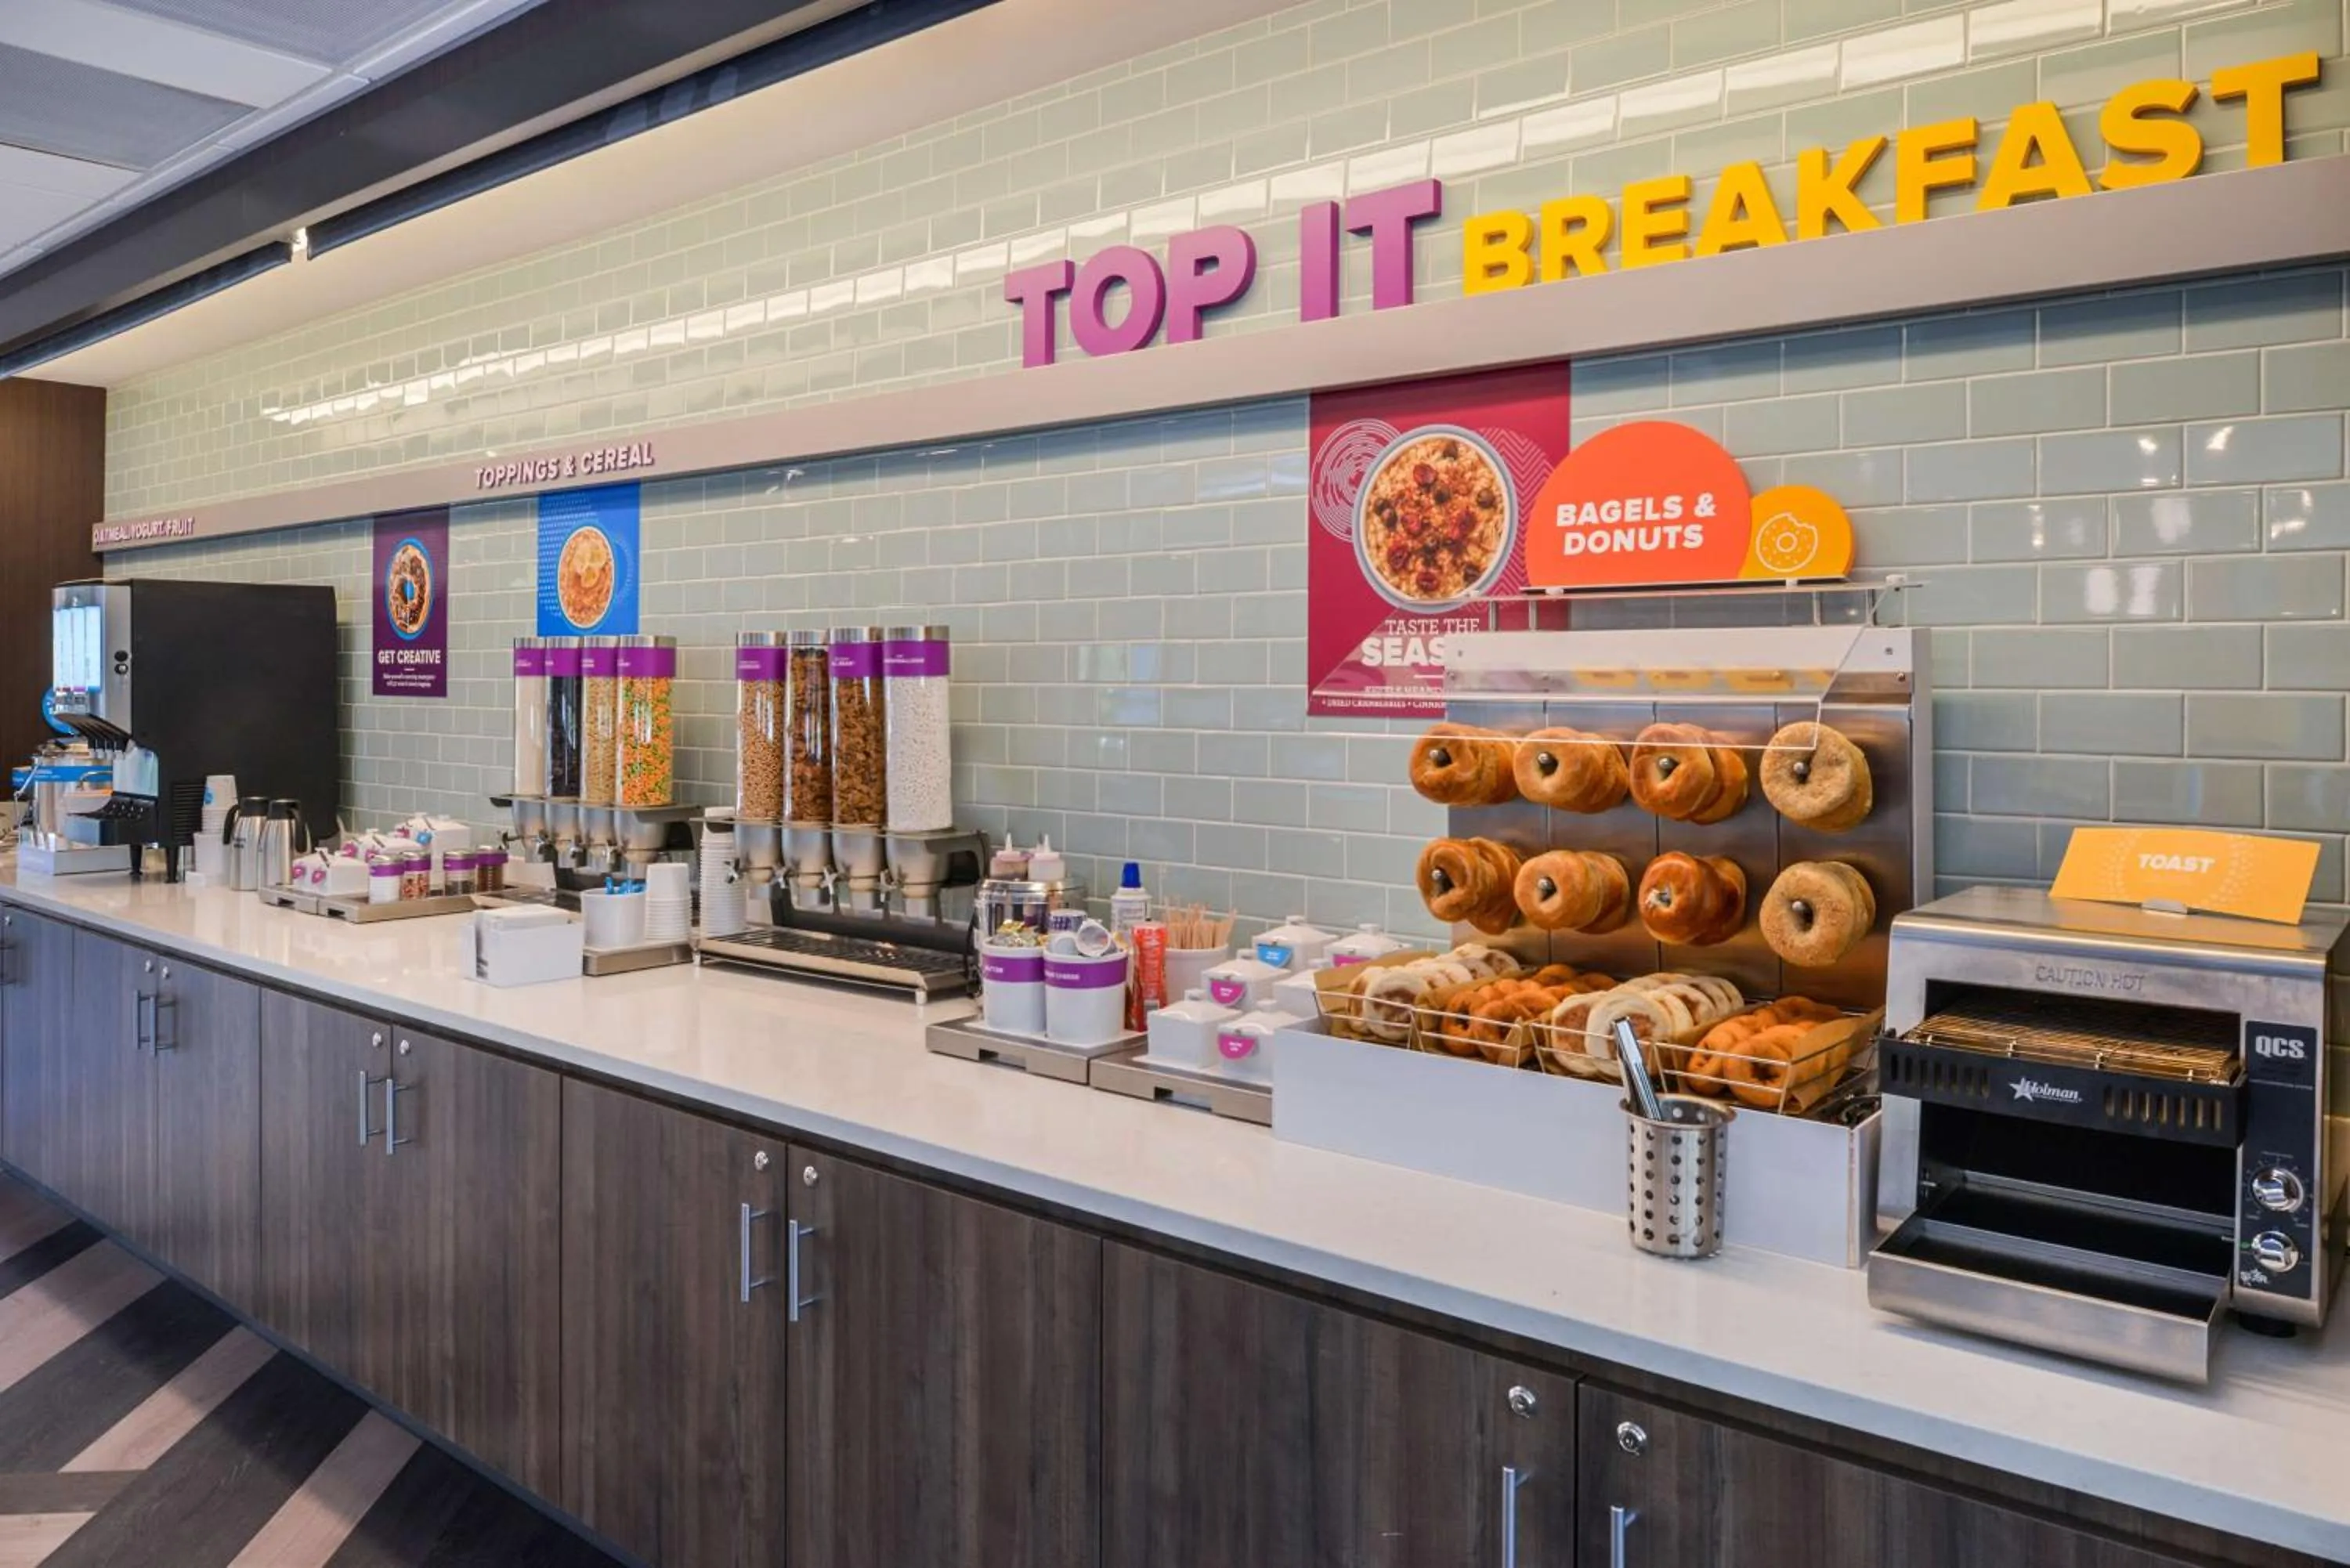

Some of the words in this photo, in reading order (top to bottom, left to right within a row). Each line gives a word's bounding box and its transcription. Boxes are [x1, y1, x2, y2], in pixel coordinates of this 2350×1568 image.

[1004, 224, 1257, 369] TOP
[1300, 179, 1442, 322] IT
[1462, 50, 2320, 296] BREAKFAST
[475, 457, 559, 489] TOPPINGS
[564, 453, 577, 478] &
[580, 443, 655, 474] CEREAL
[1556, 495, 1683, 526] BAGELS
[1694, 492, 1716, 517] &
[168, 516, 194, 536] FRUIT
[1564, 523, 1704, 555] DONUTS
[1385, 619, 1439, 635] TASTE
[1444, 618, 1480, 634] THE
[378, 649, 396, 664] GET
[397, 649, 441, 664] CREATIVE
[1361, 637, 1445, 666] SEAS
[2138, 853, 2215, 873] TOAST
[2035, 964, 2109, 989] CAUTION
[2110, 971, 2146, 991] HOT
[2255, 1035, 2305, 1059] QCS
